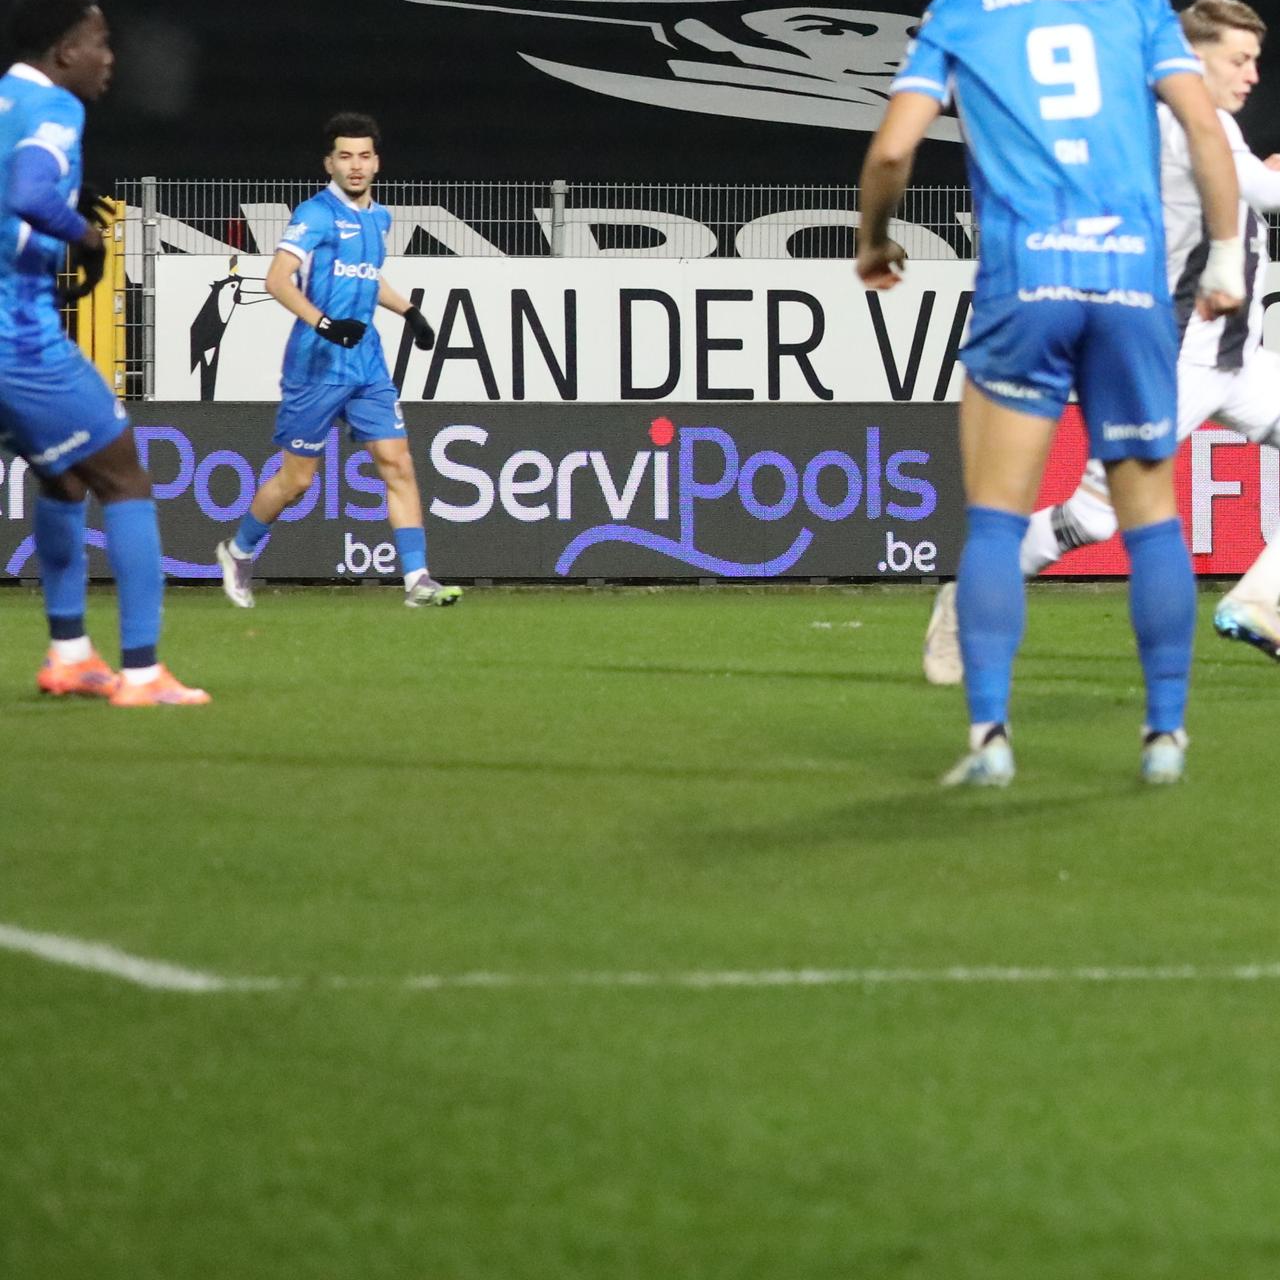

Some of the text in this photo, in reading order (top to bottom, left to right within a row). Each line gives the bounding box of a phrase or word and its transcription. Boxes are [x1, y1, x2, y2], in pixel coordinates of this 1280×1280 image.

[1027, 23, 1103, 121] 9
[619, 288, 834, 401] DER
[430, 417, 937, 532] ServiPools
[336, 532, 396, 574] .be
[878, 531, 937, 572] .be
